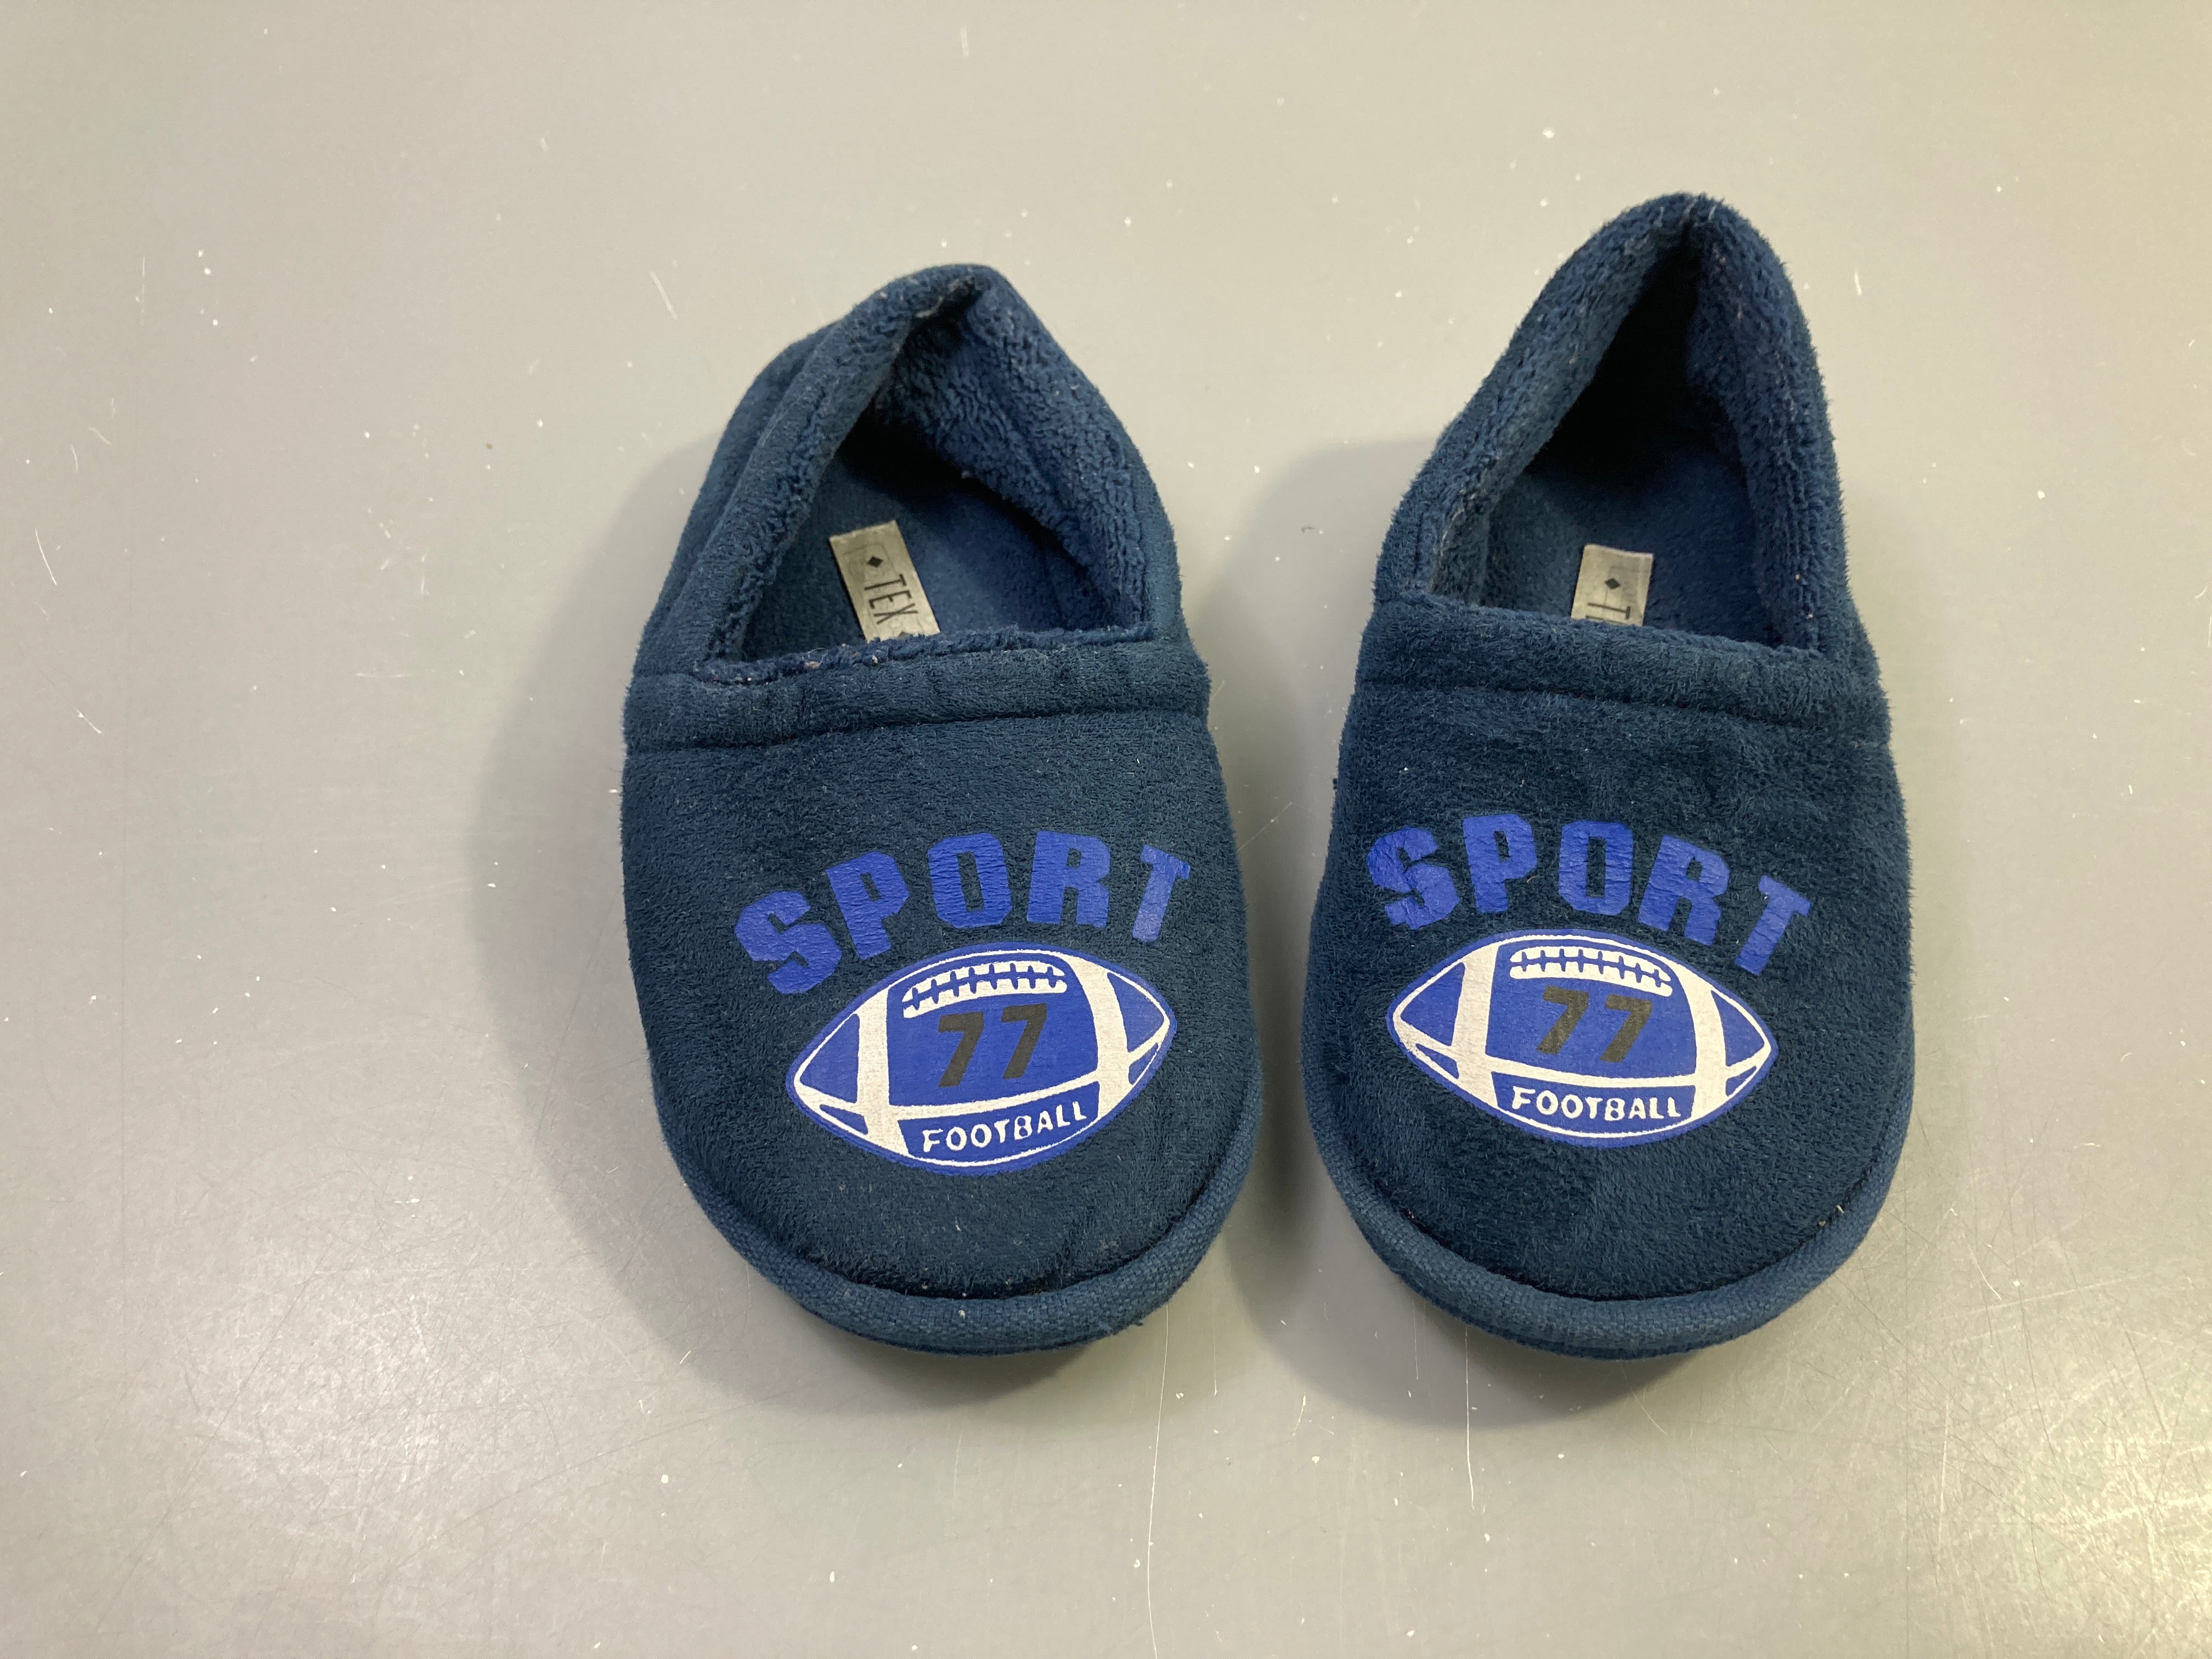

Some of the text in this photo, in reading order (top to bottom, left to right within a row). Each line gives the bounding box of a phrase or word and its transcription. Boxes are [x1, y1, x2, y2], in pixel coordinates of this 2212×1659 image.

[864, 574, 918, 625] TEX
[733, 830, 1191, 995] SPORT
[1365, 813, 1811, 976] SPORT
[937, 1002, 1048, 1088] 77
[1537, 985, 1652, 1063] 77
[922, 1100, 1087, 1153] FOOTBALL
[1511, 1086, 1682, 1122] FOOTBALL
